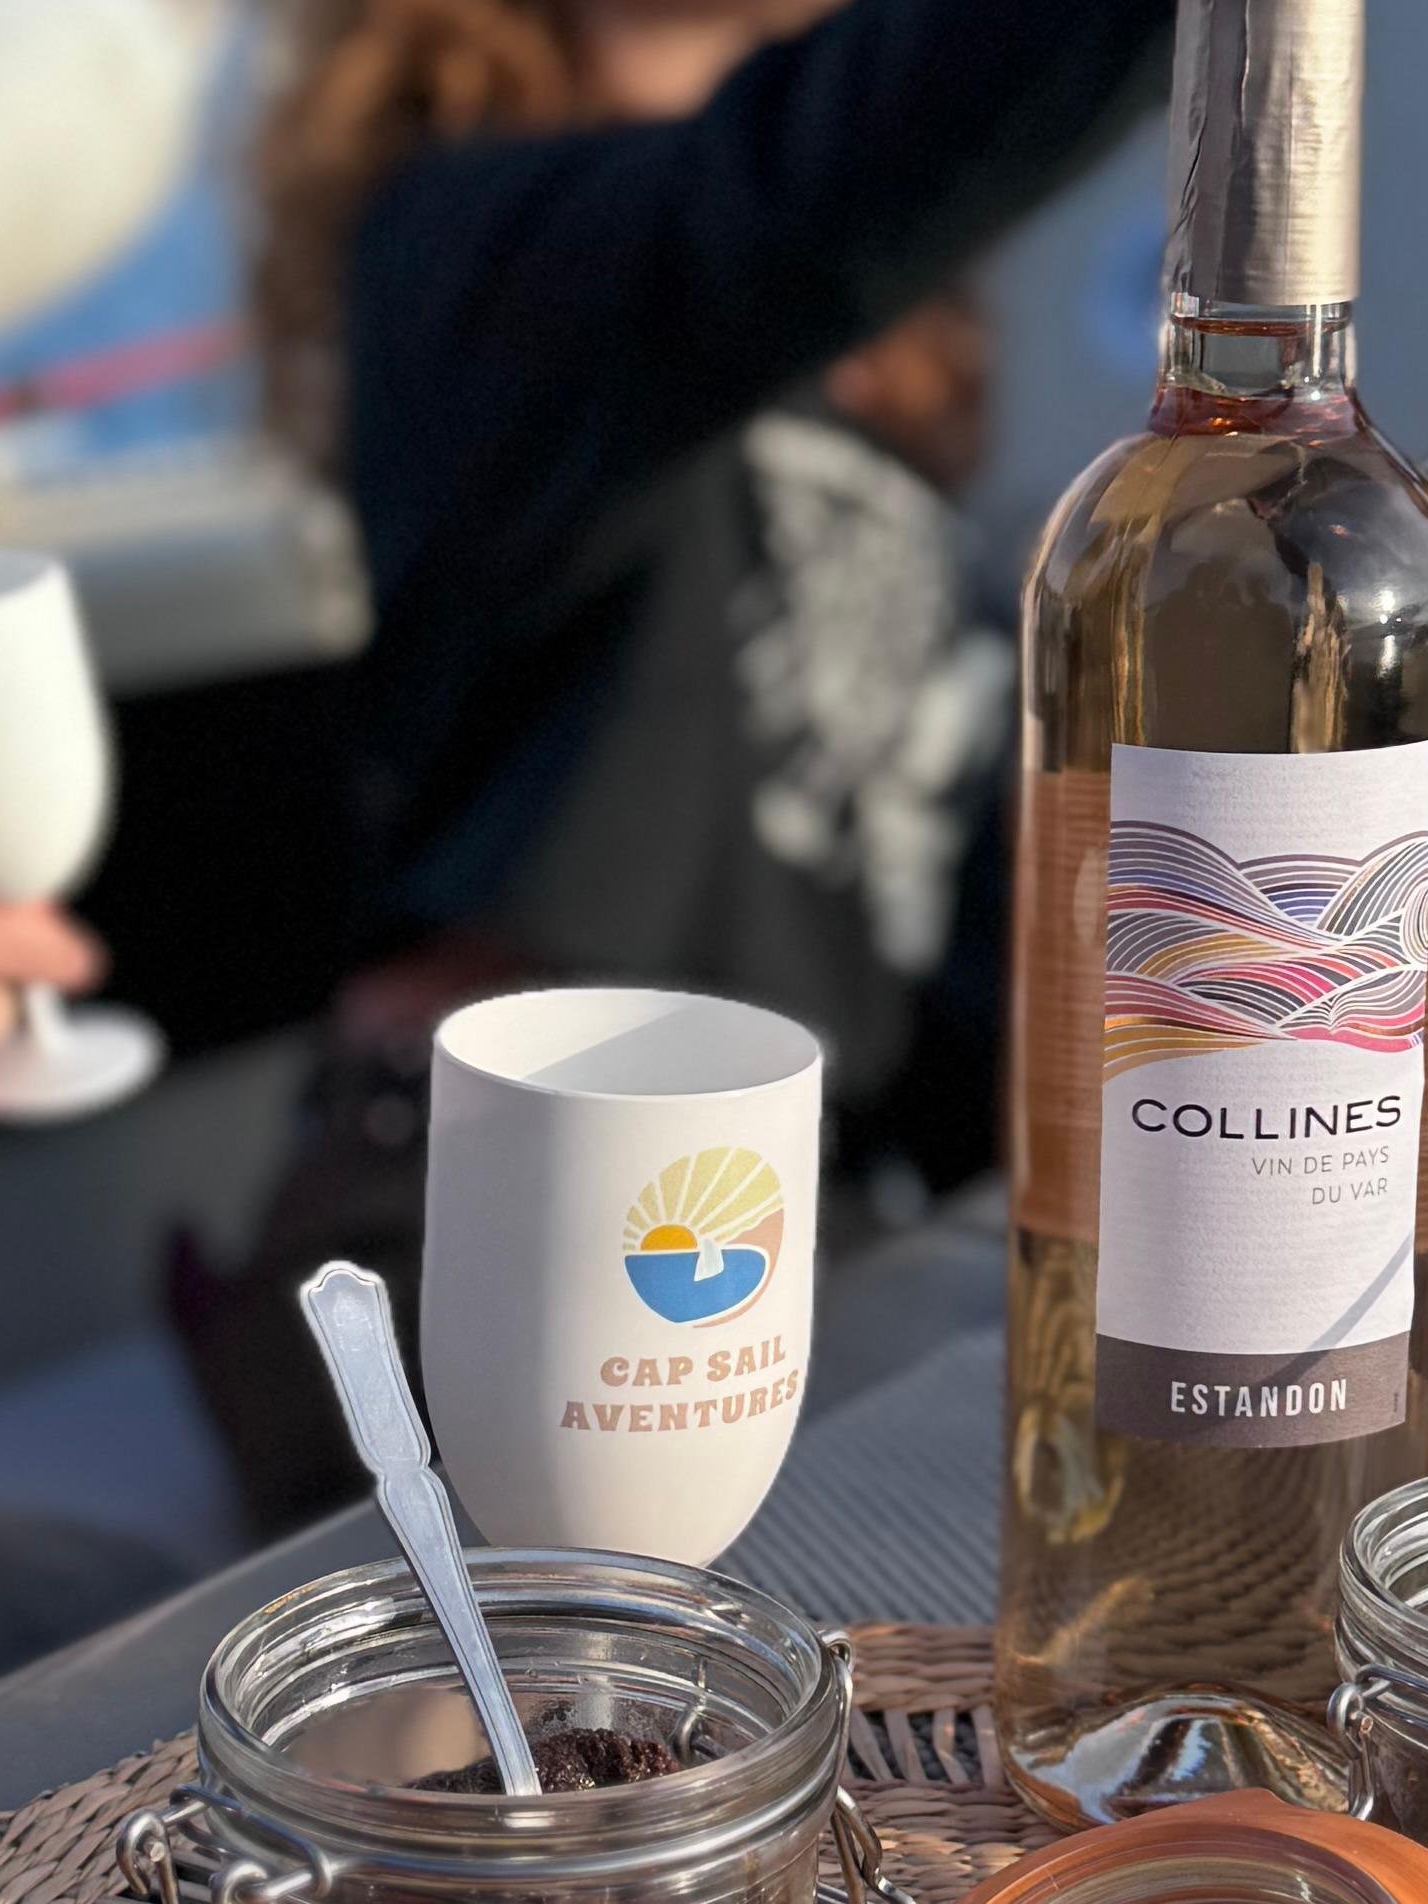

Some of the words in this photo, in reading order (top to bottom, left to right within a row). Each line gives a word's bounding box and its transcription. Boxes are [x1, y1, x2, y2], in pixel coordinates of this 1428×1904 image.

[1131, 1095, 1401, 1139] COLLINES
[1251, 1157, 1292, 1175] VIN
[1304, 1154, 1332, 1174] DE
[1342, 1146, 1389, 1170] PAYS
[1312, 1185, 1341, 1205] DU
[1350, 1177, 1388, 1200] VAR
[600, 1356, 694, 1387] CAP
[706, 1335, 786, 1382] SAIL
[560, 1369, 799, 1432] AVENTURES
[1171, 1379, 1347, 1417] ESTANDON
